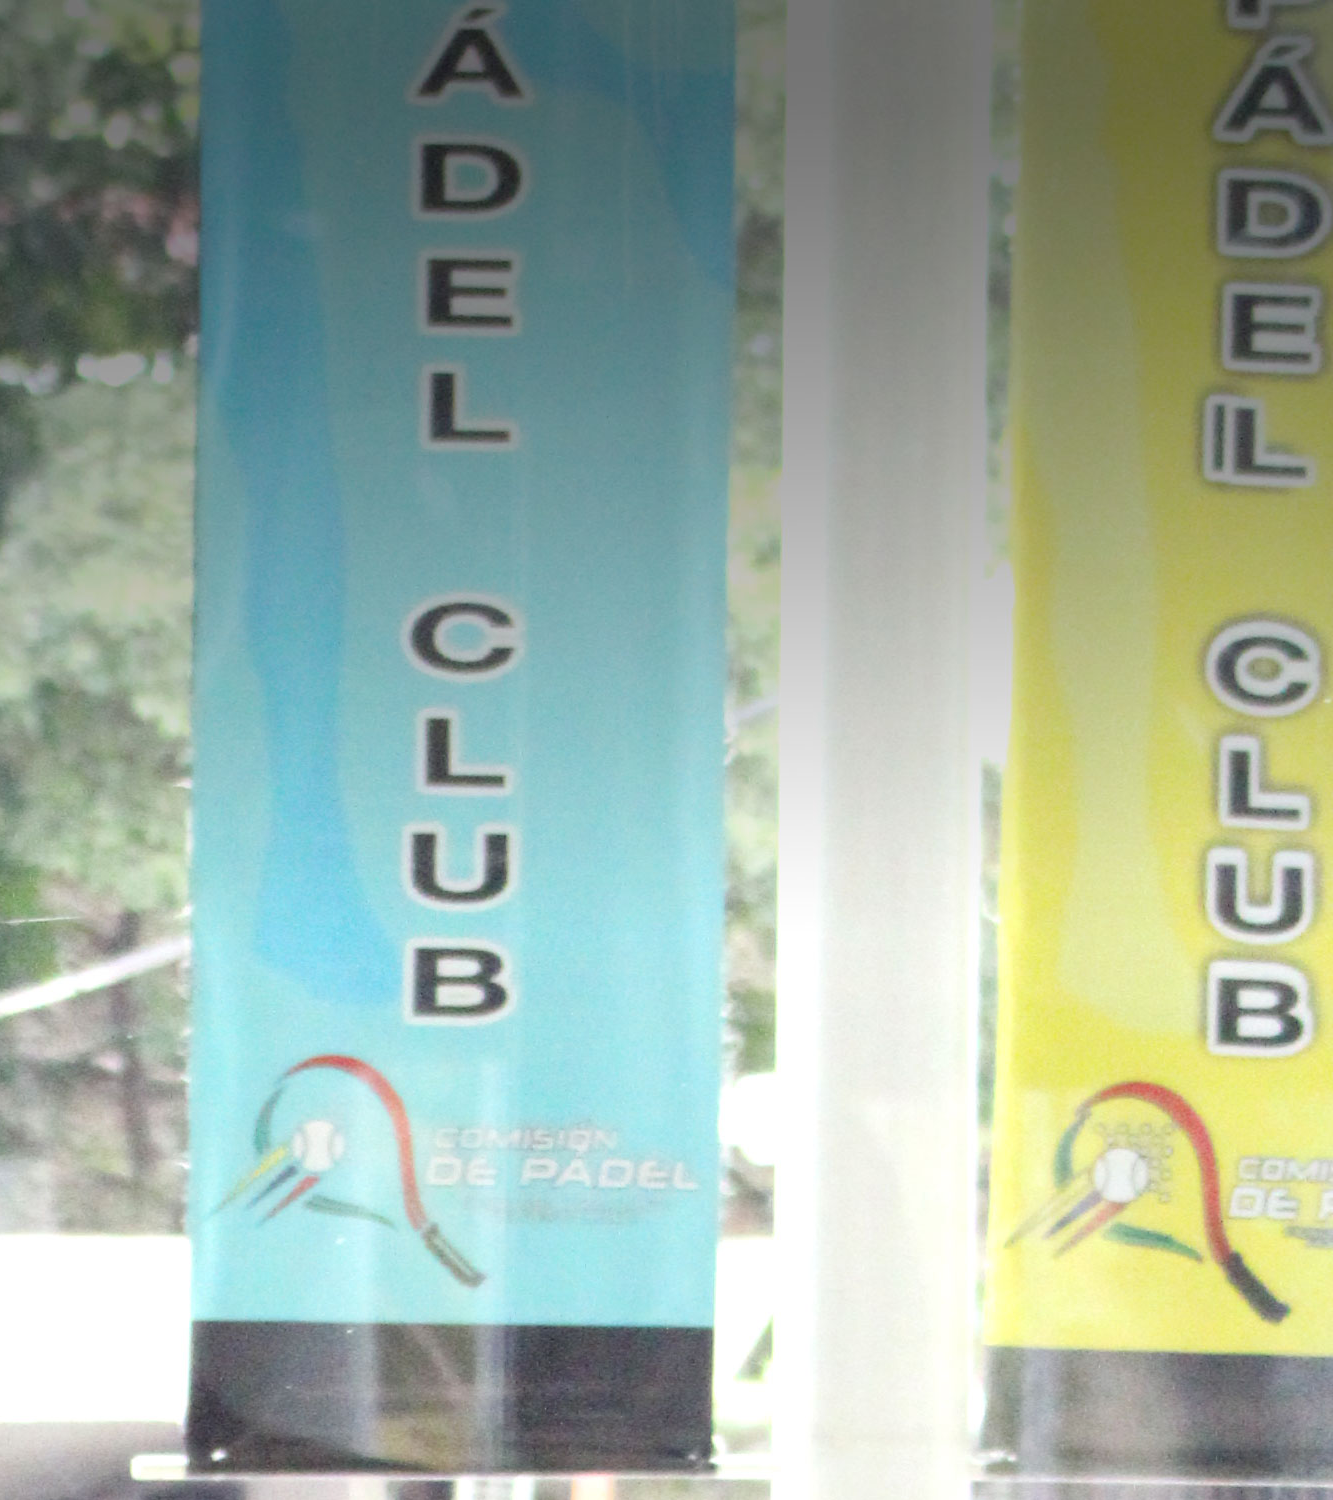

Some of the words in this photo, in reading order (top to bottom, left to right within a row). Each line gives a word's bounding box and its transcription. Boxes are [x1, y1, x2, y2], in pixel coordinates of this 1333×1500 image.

[406, 600, 515, 1022] CLUB
[1207, 618, 1323, 1055] CLUB
[427, 1156, 496, 1186] DE
[1229, 1186, 1297, 1220] DE
